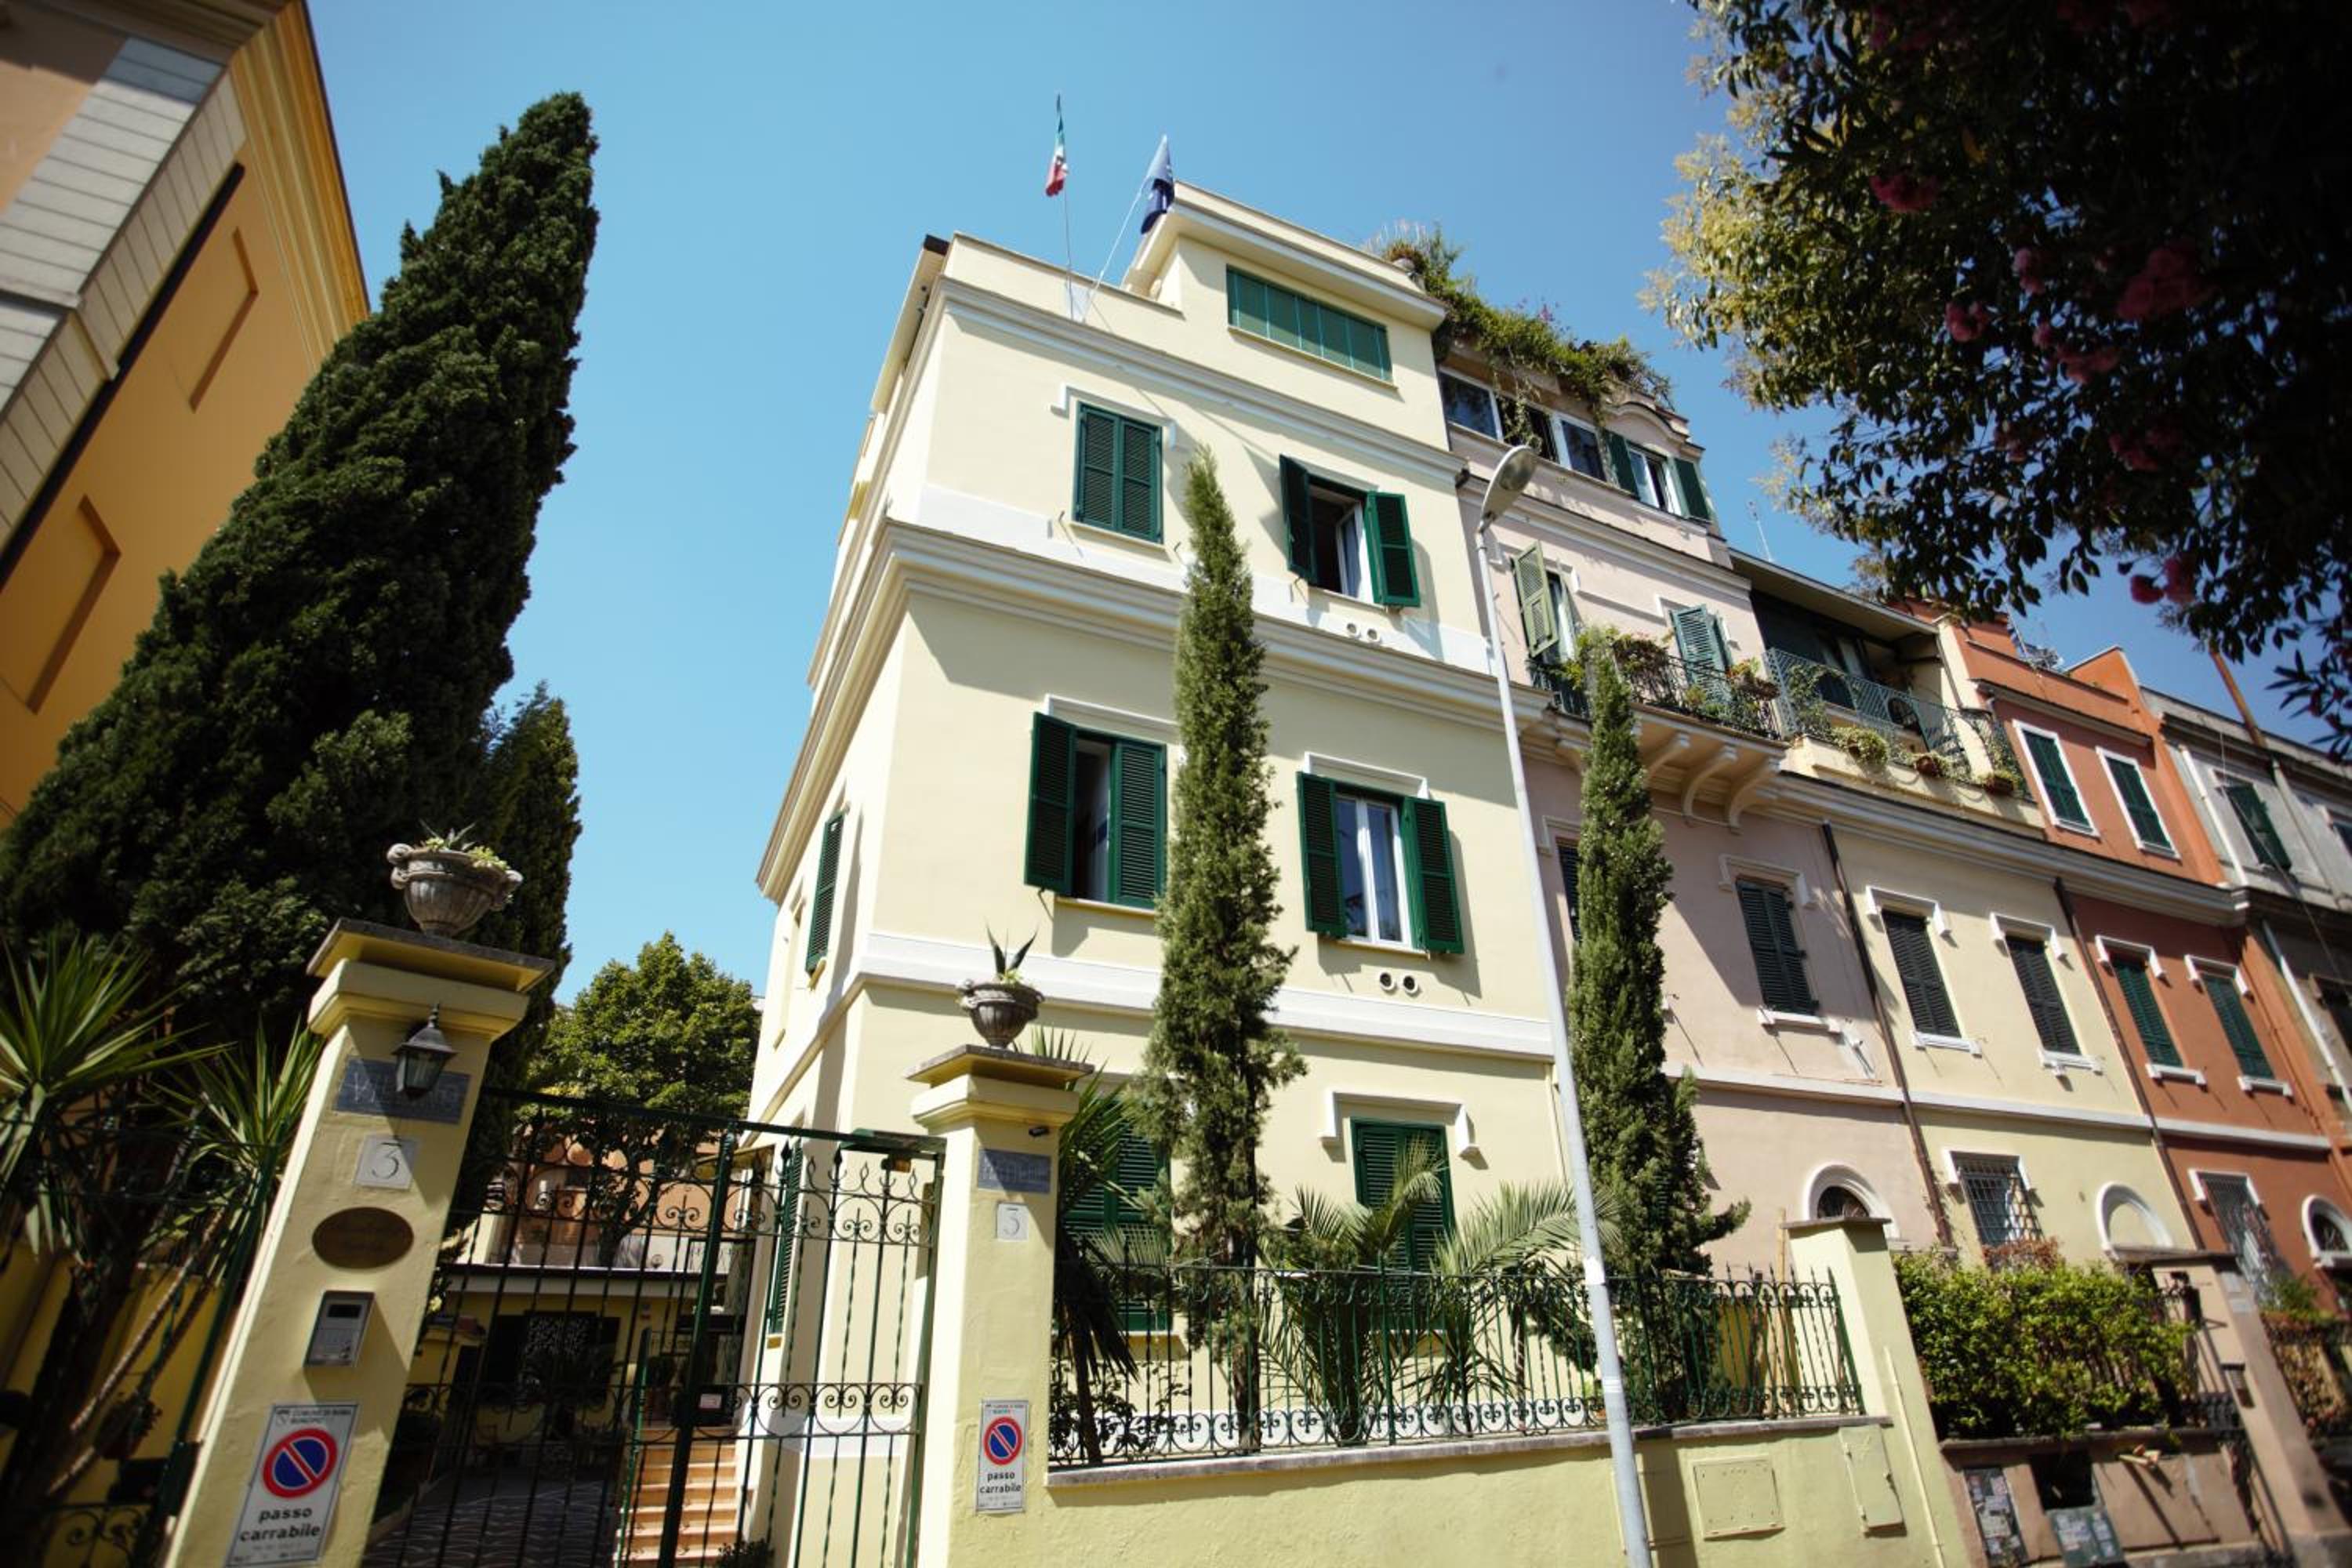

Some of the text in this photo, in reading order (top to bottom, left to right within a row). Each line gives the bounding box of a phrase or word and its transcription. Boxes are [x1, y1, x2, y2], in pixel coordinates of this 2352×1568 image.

[372, 1142, 402, 1180] 3
[987, 1472, 1015, 1483] passo
[979, 1482, 1022, 1494] carrabile
[258, 1508, 313, 1524] passo
[240, 1523, 321, 1542] carrabile
